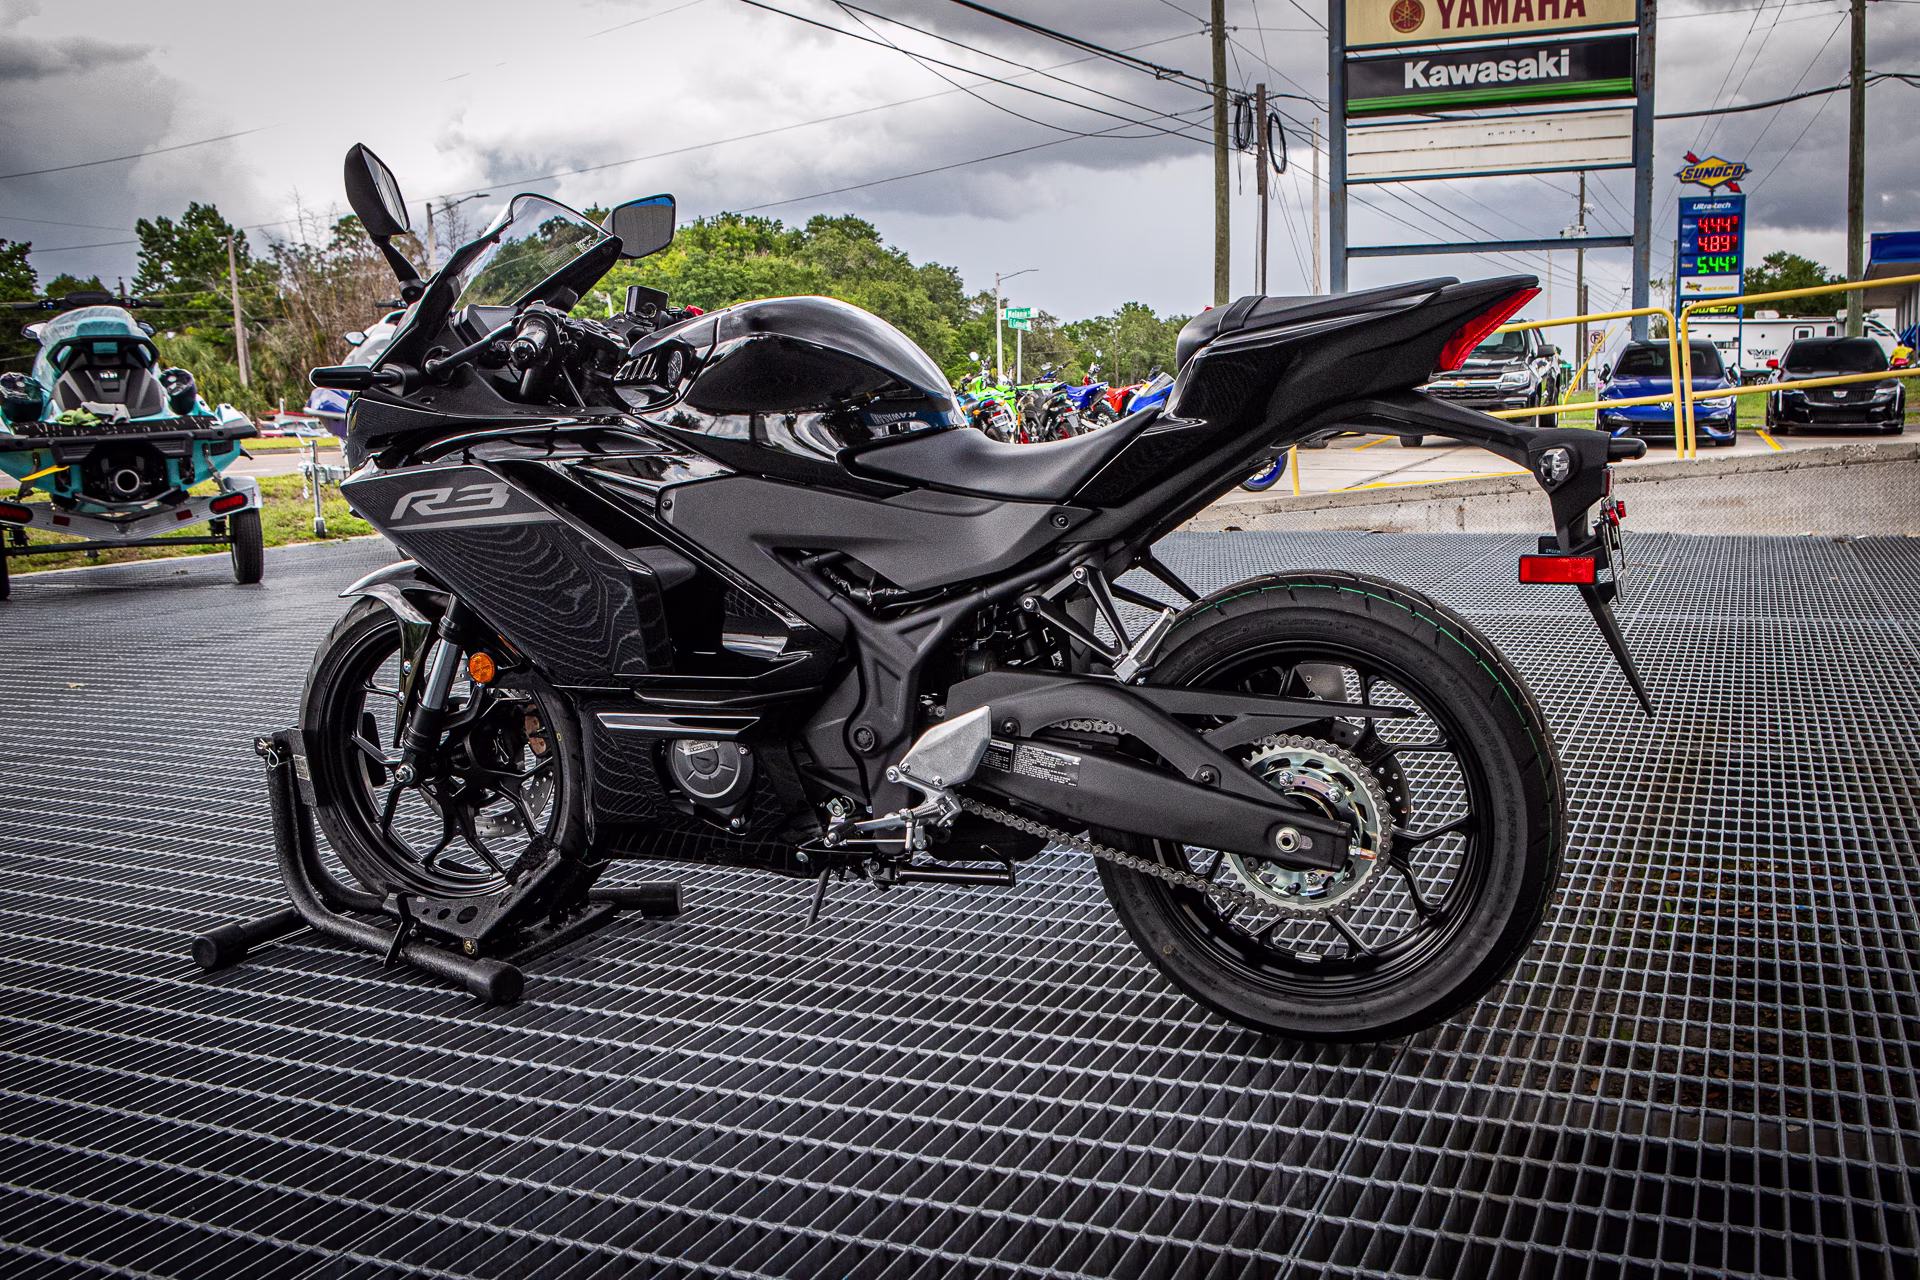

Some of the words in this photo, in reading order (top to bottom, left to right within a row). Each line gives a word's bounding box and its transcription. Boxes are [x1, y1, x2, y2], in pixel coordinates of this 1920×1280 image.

[1404, 49, 1570, 89] Kawasaki
[1684, 165, 1743, 179] SUNOCO
[390, 482, 510, 520] R3
